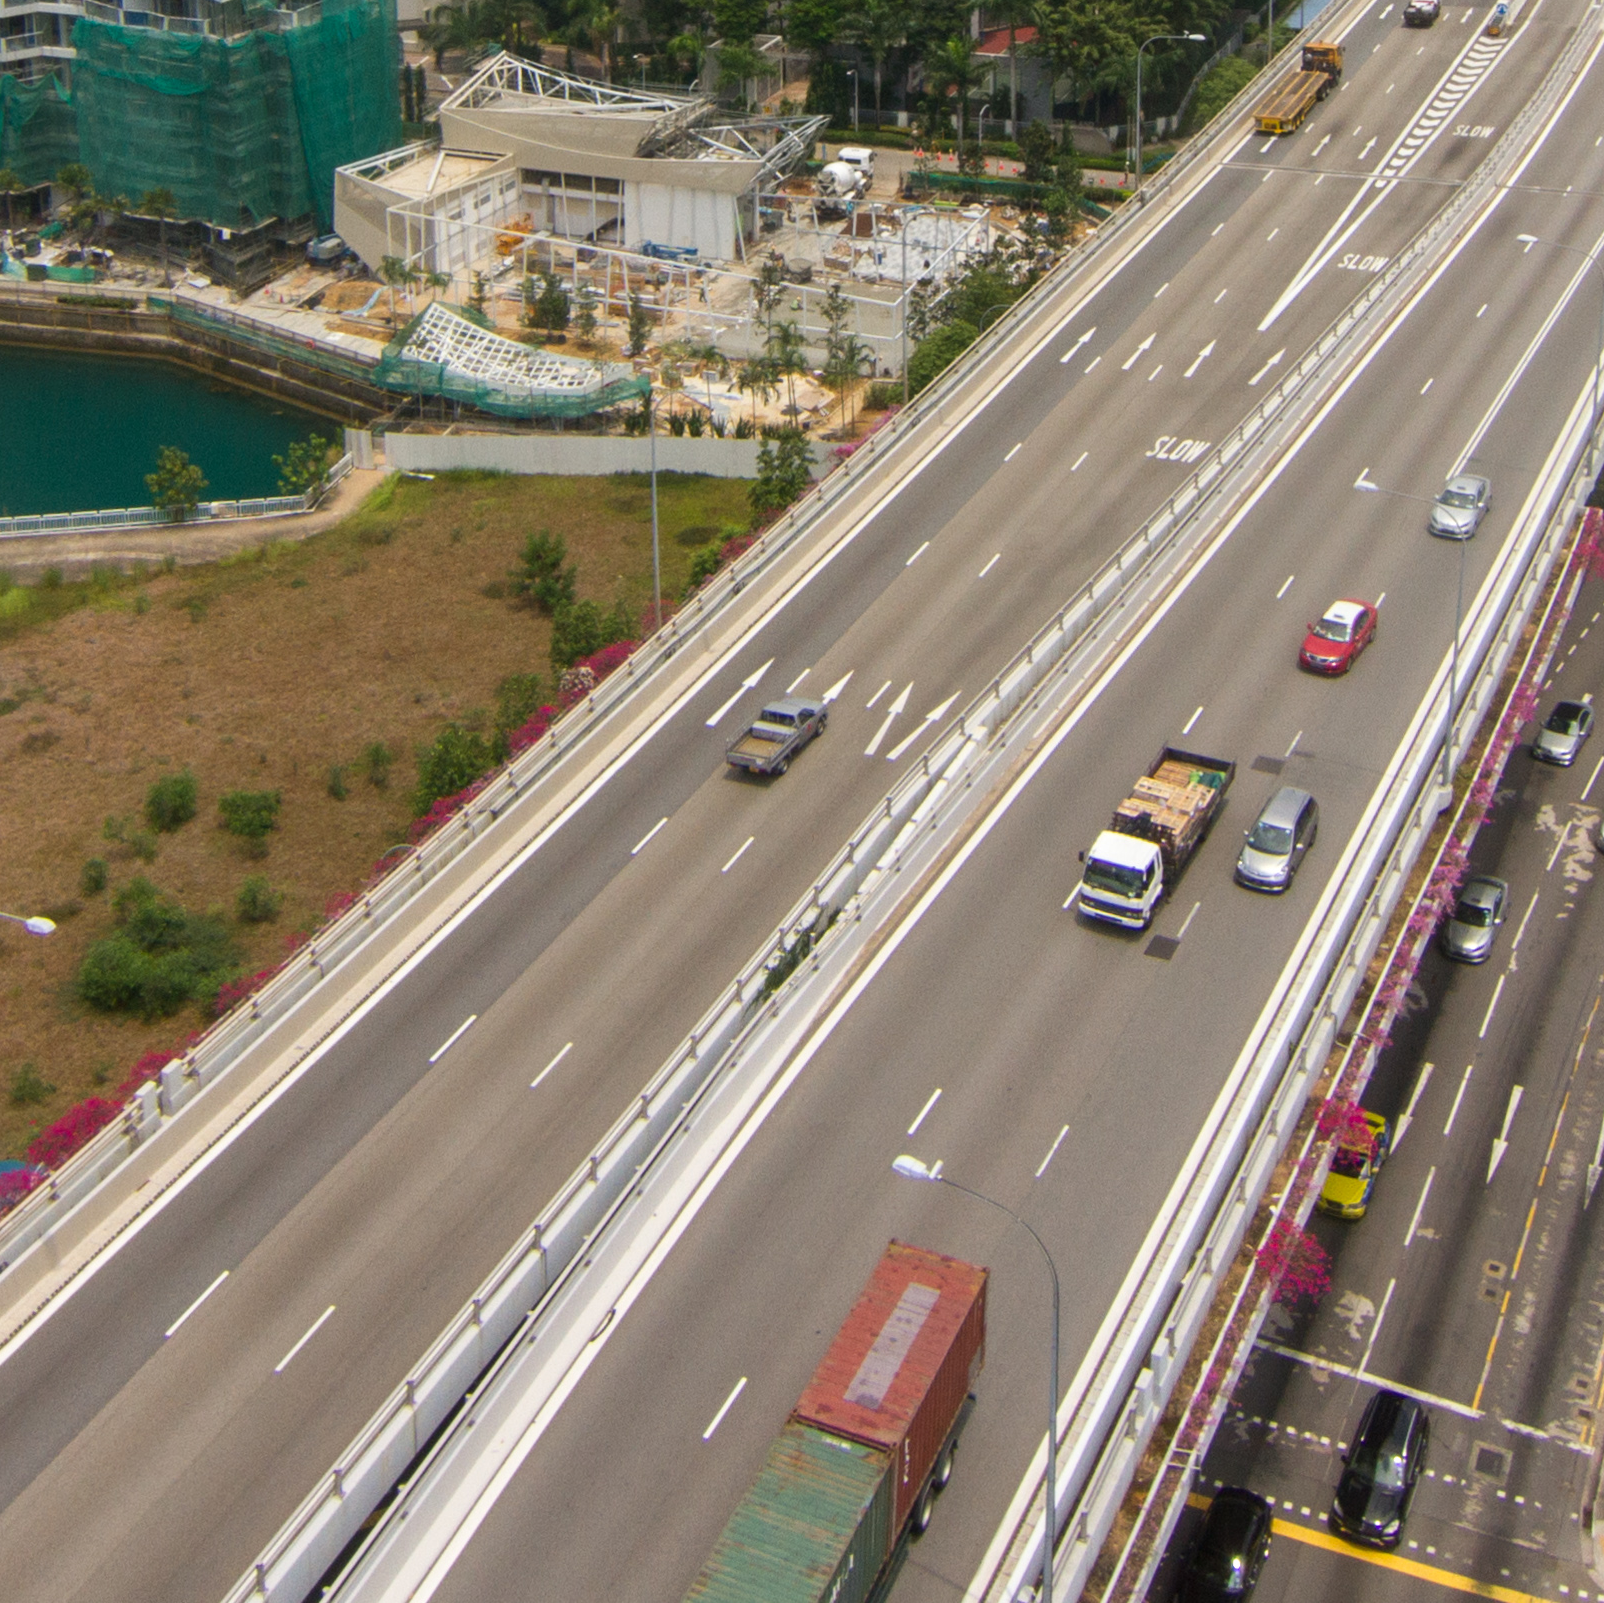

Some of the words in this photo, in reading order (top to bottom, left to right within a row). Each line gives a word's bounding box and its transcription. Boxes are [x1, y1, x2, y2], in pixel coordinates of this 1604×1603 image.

[1452, 124, 1496, 138] SLOW
[1338, 253, 1389, 273] SLOW
[1145, 435, 1211, 463] SLOW
